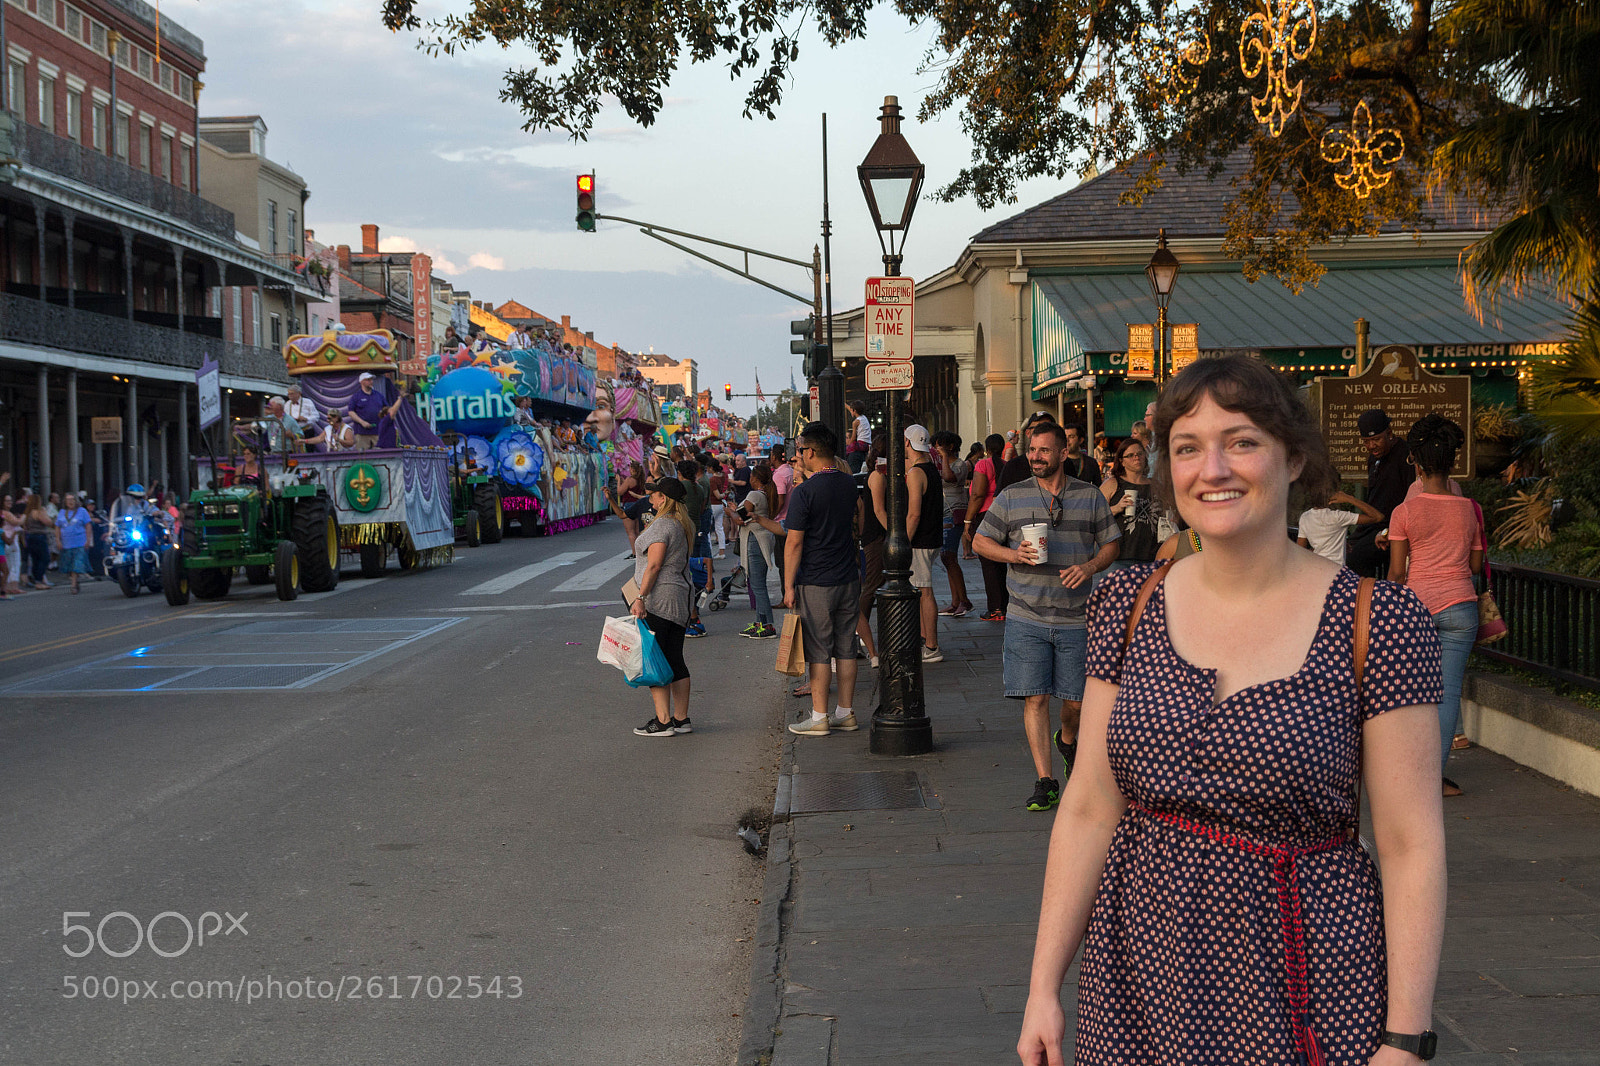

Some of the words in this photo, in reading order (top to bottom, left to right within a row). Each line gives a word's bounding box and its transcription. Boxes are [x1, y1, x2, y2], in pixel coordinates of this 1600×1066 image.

[866, 284, 880, 299] NO
[881, 287, 911, 298] STOPPING
[876, 308, 904, 321] ANY
[875, 323, 904, 335] TIME
[1130, 328, 1153, 336] MAKING
[1173, 328, 1196, 336] MAKING
[1432, 344, 1504, 358] FRENCH
[873, 367, 907, 376] TOW-AWAY
[881, 376, 897, 384] ZONE
[1344, 384, 1374, 394] NEW
[1382, 383, 1446, 394] ORLEANS
[1353, 403, 1381, 411] sighted
[1431, 403, 1462, 411] portage
[603, 634, 620, 648] THANK
